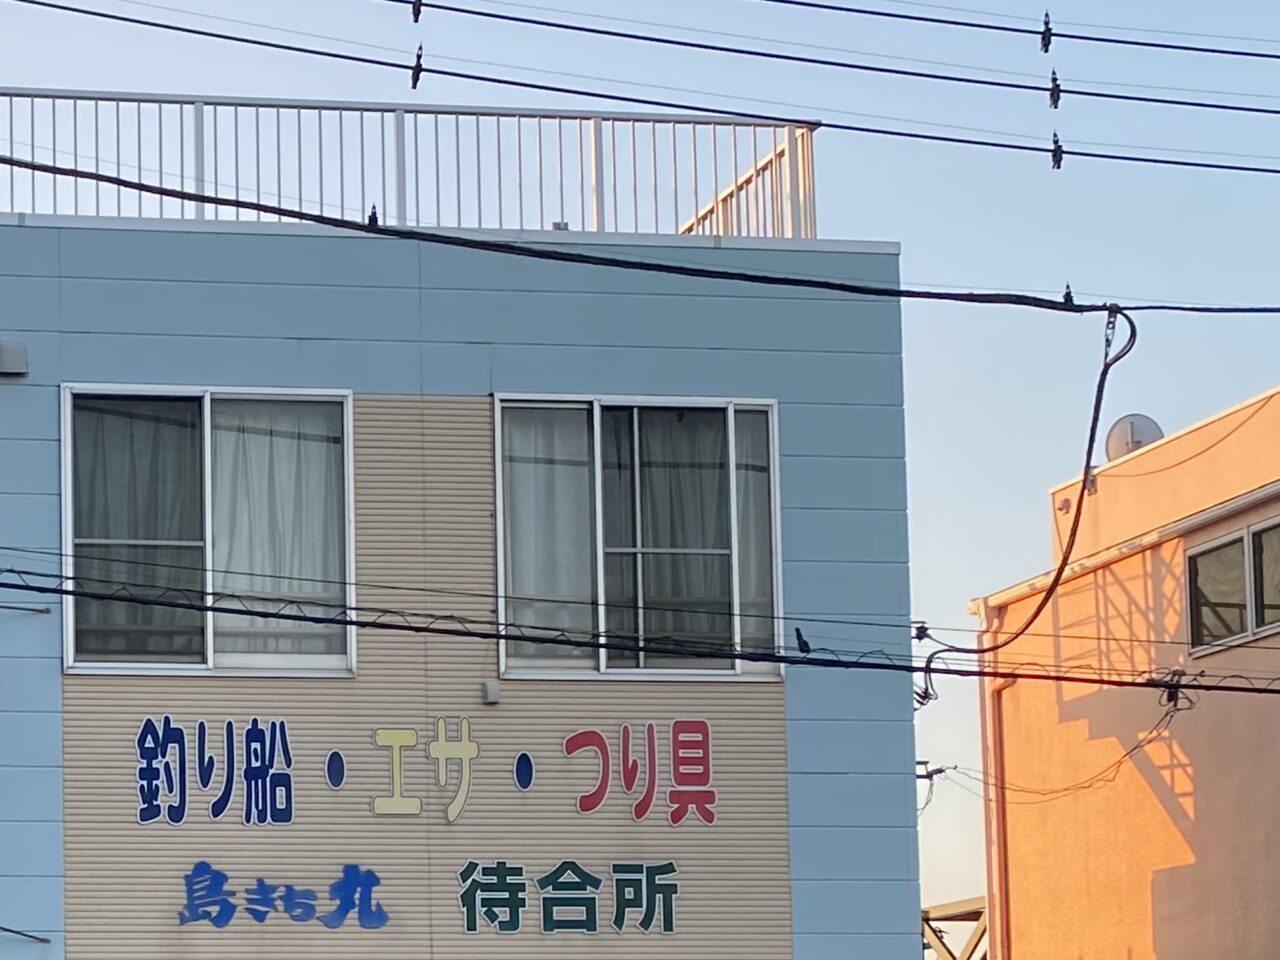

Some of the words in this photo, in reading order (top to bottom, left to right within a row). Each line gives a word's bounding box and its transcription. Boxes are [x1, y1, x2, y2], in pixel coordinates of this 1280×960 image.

[179, 860, 390, 930] 島きち丸
[457, 859, 680, 935] 待合所
